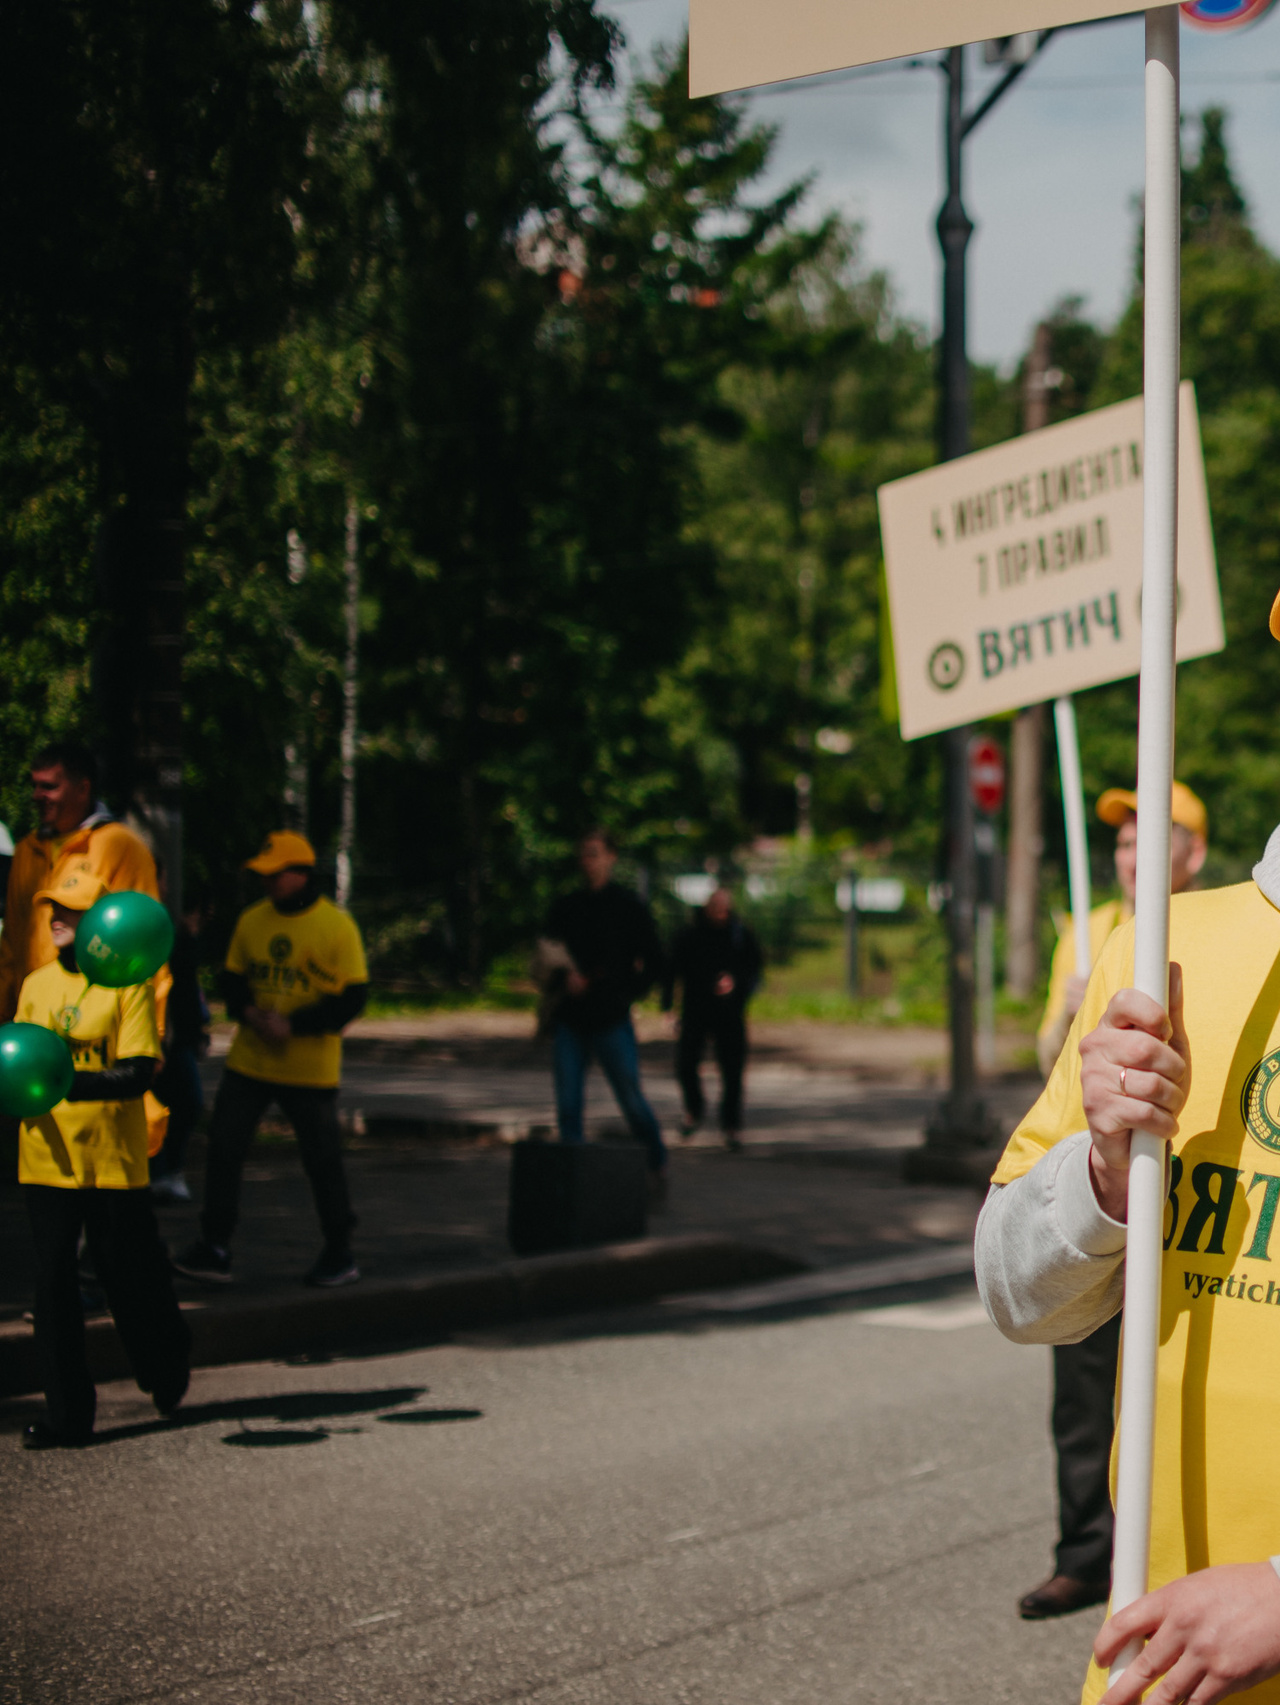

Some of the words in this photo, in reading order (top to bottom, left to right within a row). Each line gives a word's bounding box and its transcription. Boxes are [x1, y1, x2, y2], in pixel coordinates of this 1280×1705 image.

[953, 440, 1143, 540] ИНГРЕДИЕНТА
[998, 517, 1111, 589] ПРАВИЛ
[978, 590, 1121, 680] ВЯТИЧ
